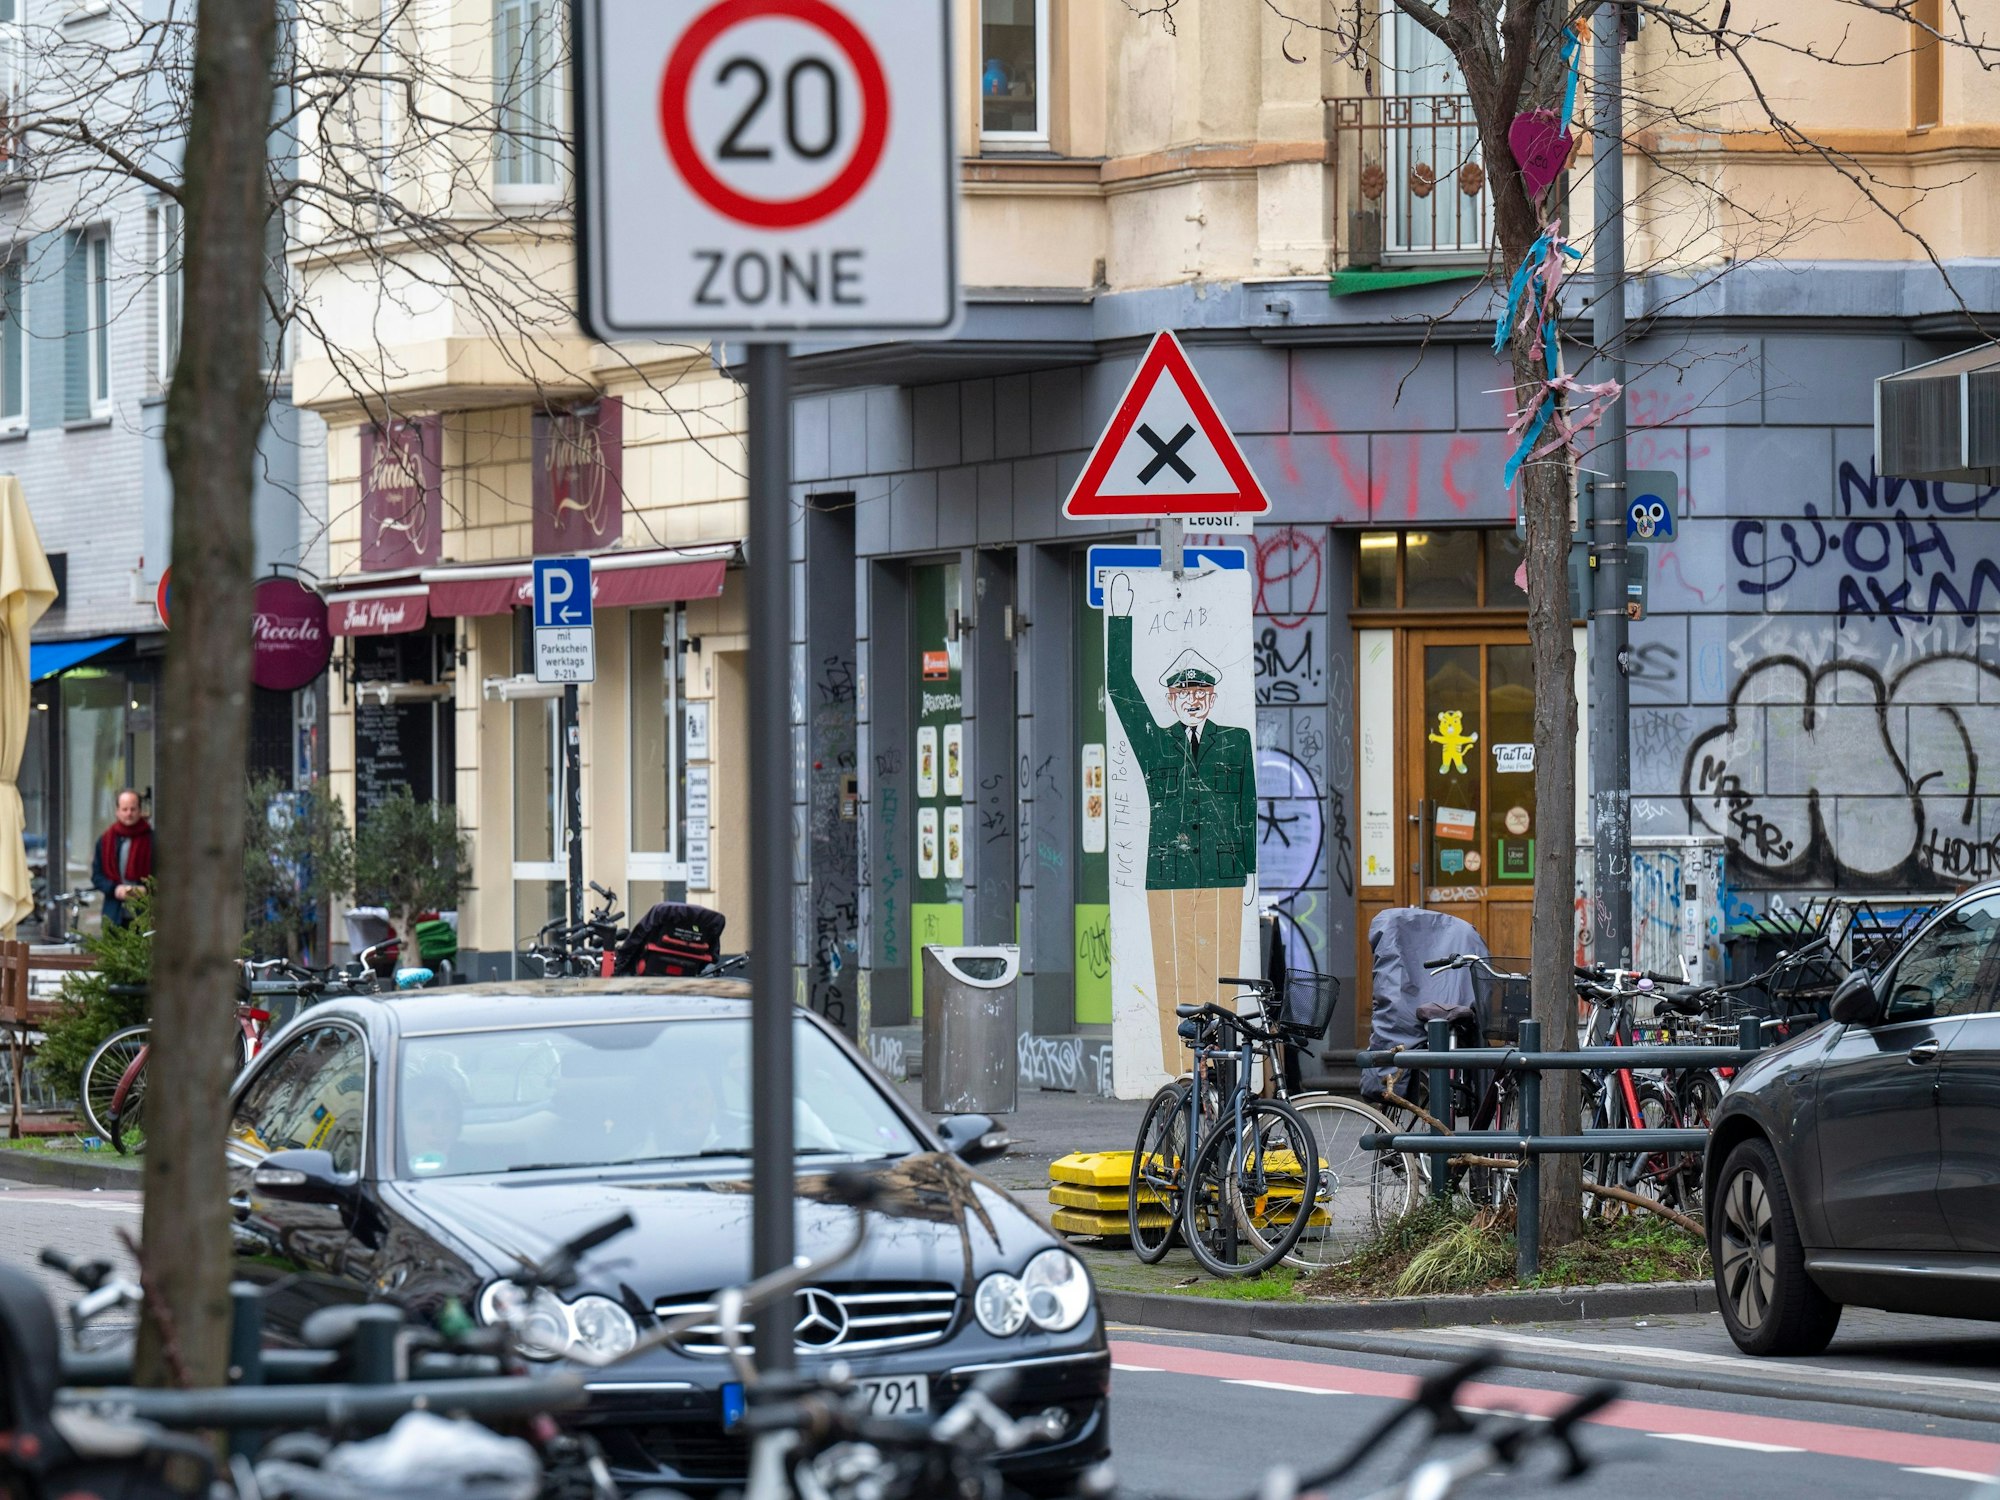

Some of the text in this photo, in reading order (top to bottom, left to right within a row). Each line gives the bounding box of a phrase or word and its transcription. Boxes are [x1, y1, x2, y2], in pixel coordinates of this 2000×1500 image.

[715, 54, 842, 162] 20
[691, 250, 867, 307] ZONE
[543, 568, 574, 625] P
[251, 614, 319, 641] Piccola
[1148, 607, 1208, 636] ACAB
[541, 643, 588, 655] Parkschein
[557, 631, 571, 641] mit
[545, 657, 585, 669] werktags
[554, 669, 577, 679] 9-21h
[1114, 792, 1132, 826] THE
[1507, 851, 1524, 859] Uber
